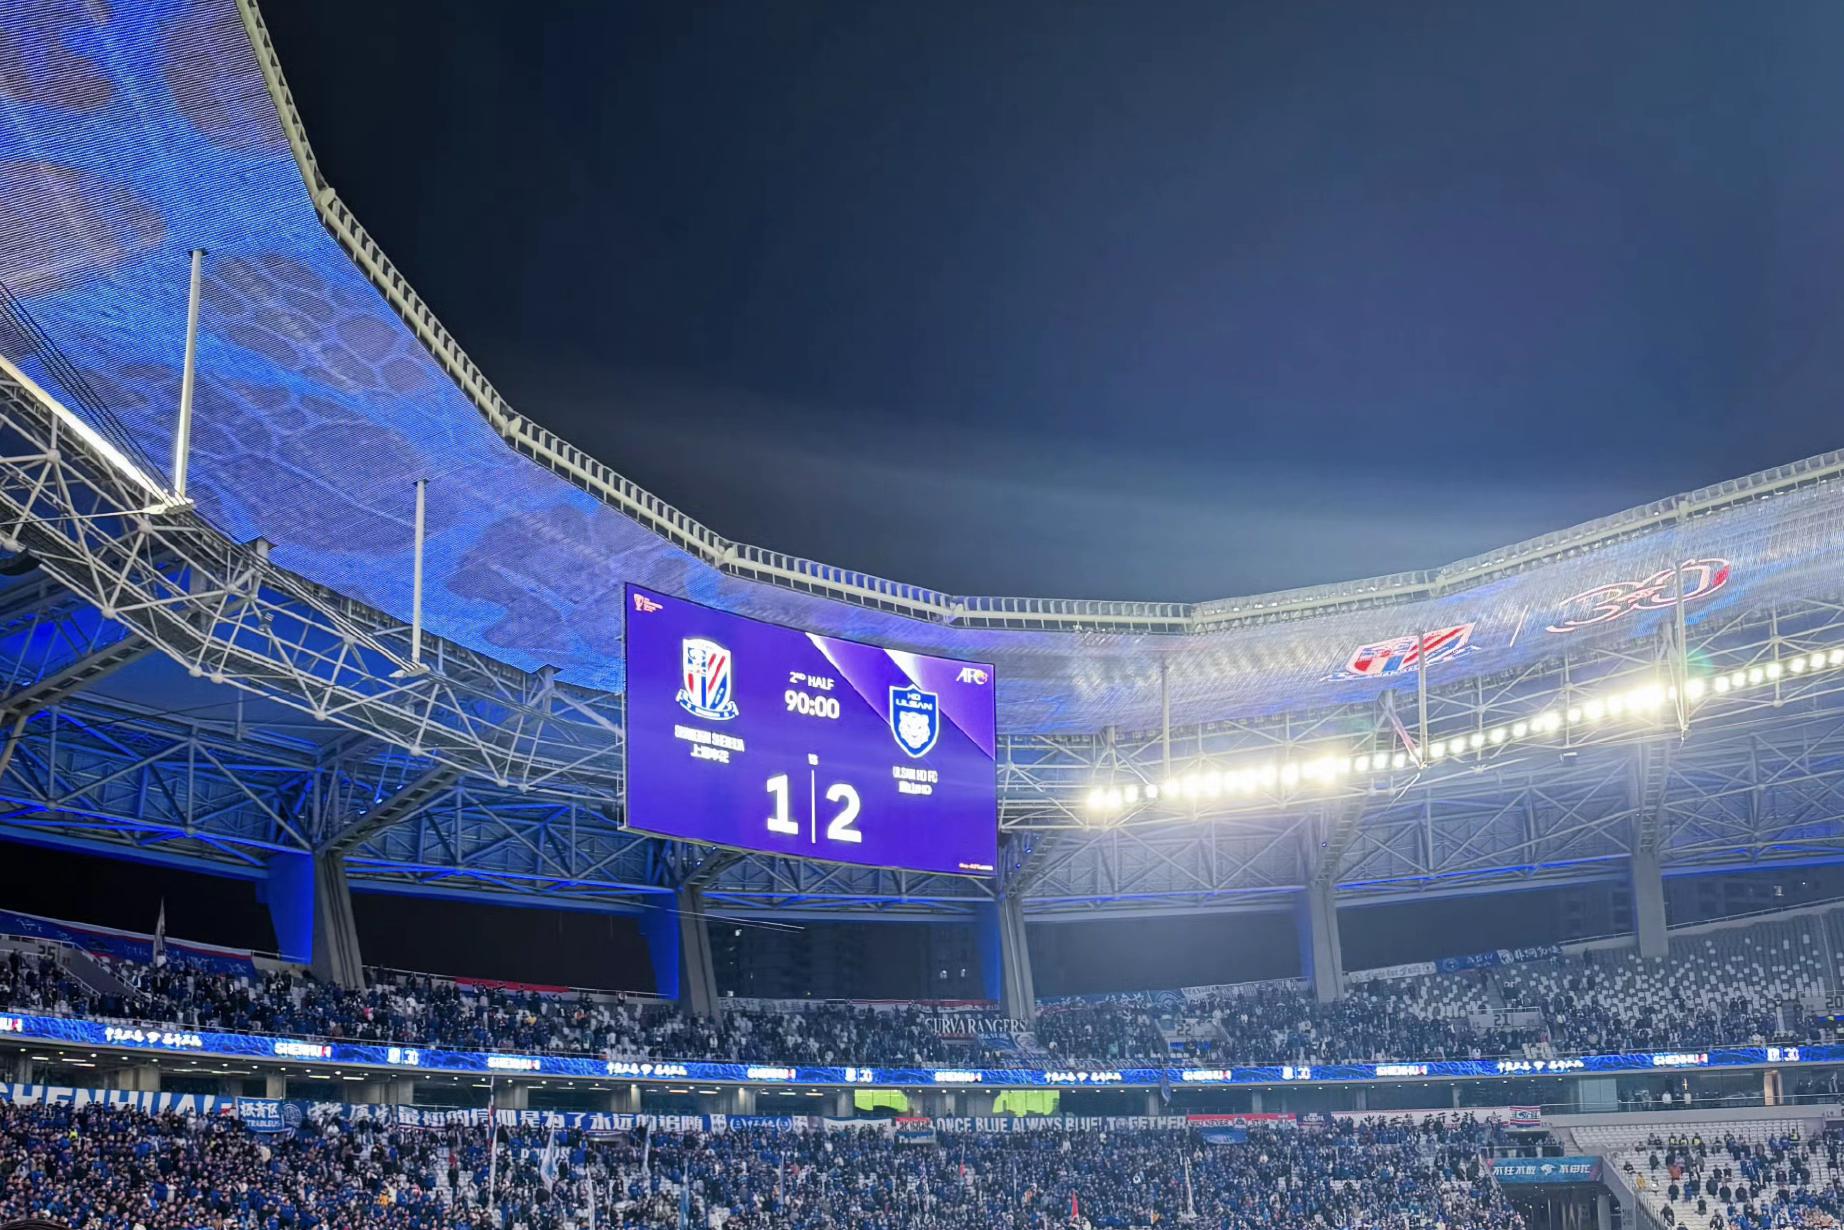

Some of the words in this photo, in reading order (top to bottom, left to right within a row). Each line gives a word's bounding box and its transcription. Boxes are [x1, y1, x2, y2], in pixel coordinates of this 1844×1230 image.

[807, 675, 835, 691] HALF
[784, 690, 840, 719] 90:00
[896, 698, 933, 710] ULSAN
[766, 774, 799, 835] 1
[825, 783, 862, 843] 2
[967, 1018, 1027, 1034] RANGERS
[1653, 1053, 1708, 1066] SHENHUA
[937, 1117, 971, 1132] ONCE
[975, 1117, 1007, 1132] BLUE
[1012, 1117, 1062, 1133] ALWAYS
